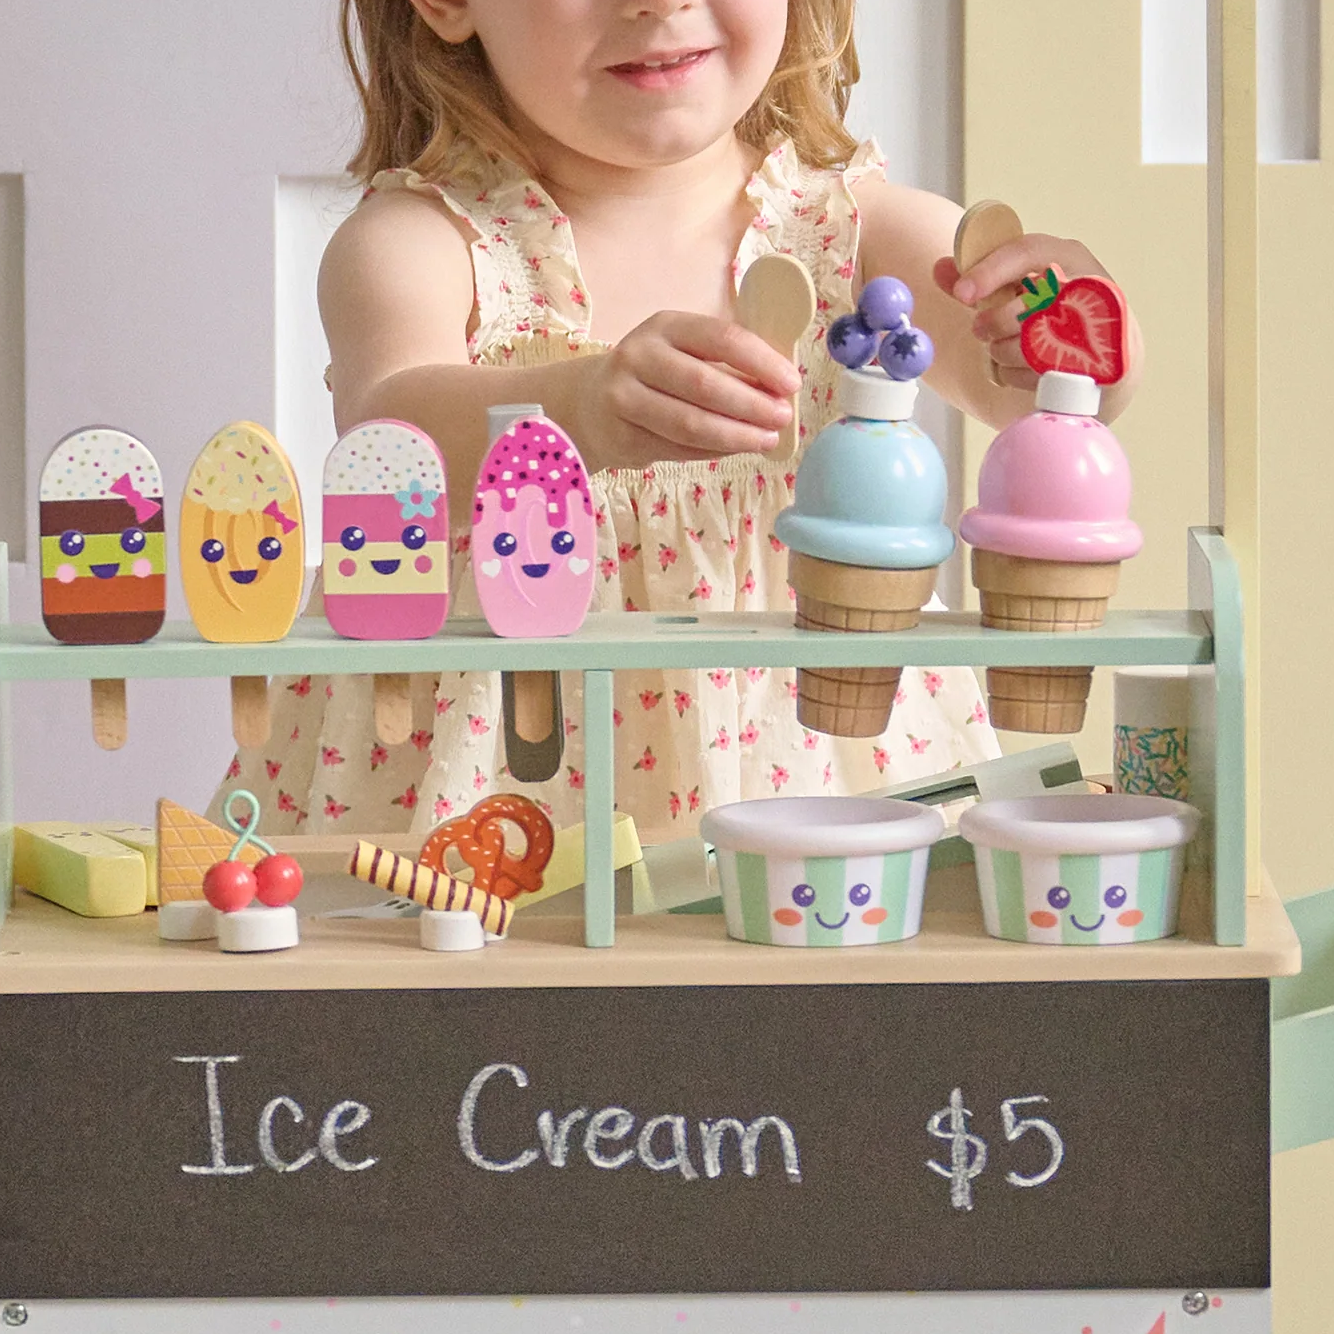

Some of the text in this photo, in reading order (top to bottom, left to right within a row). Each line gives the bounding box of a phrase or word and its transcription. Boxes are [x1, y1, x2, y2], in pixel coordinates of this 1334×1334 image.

[172, 1054, 1065, 1212] Ice Cream $5
